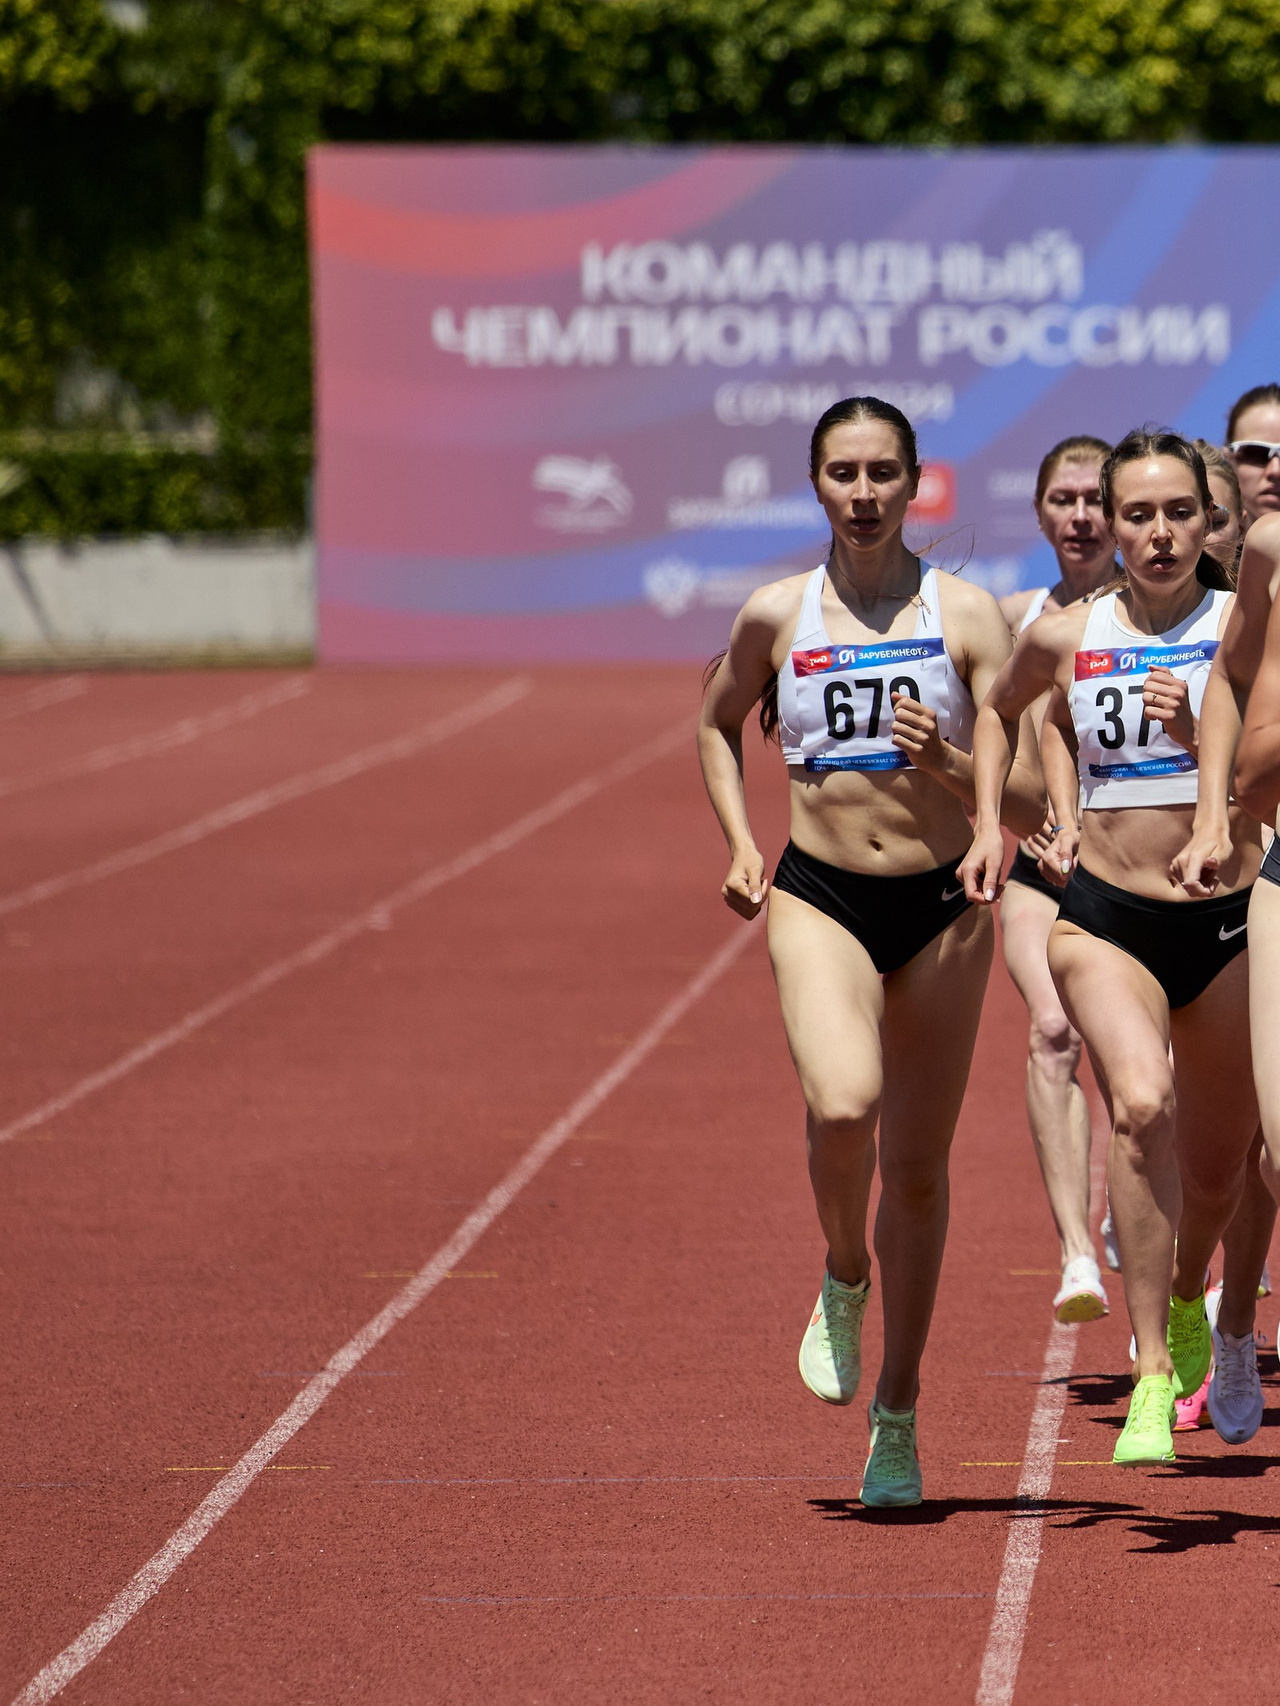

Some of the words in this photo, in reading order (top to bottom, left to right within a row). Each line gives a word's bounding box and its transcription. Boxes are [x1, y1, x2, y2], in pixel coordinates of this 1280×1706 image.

[580, 229, 1084, 308] КОМАНДНЫЙ
[432, 304, 896, 368] ЧЕМПИОНАТ
[917, 304, 1232, 368] РОССИИ
[858, 646, 928, 660] ЗАРУБЕЖНЕФТЬ
[1139, 649, 1205, 665] ЗАРУБЕЖНЕФТЬ
[1096, 686, 1166, 750] 37
